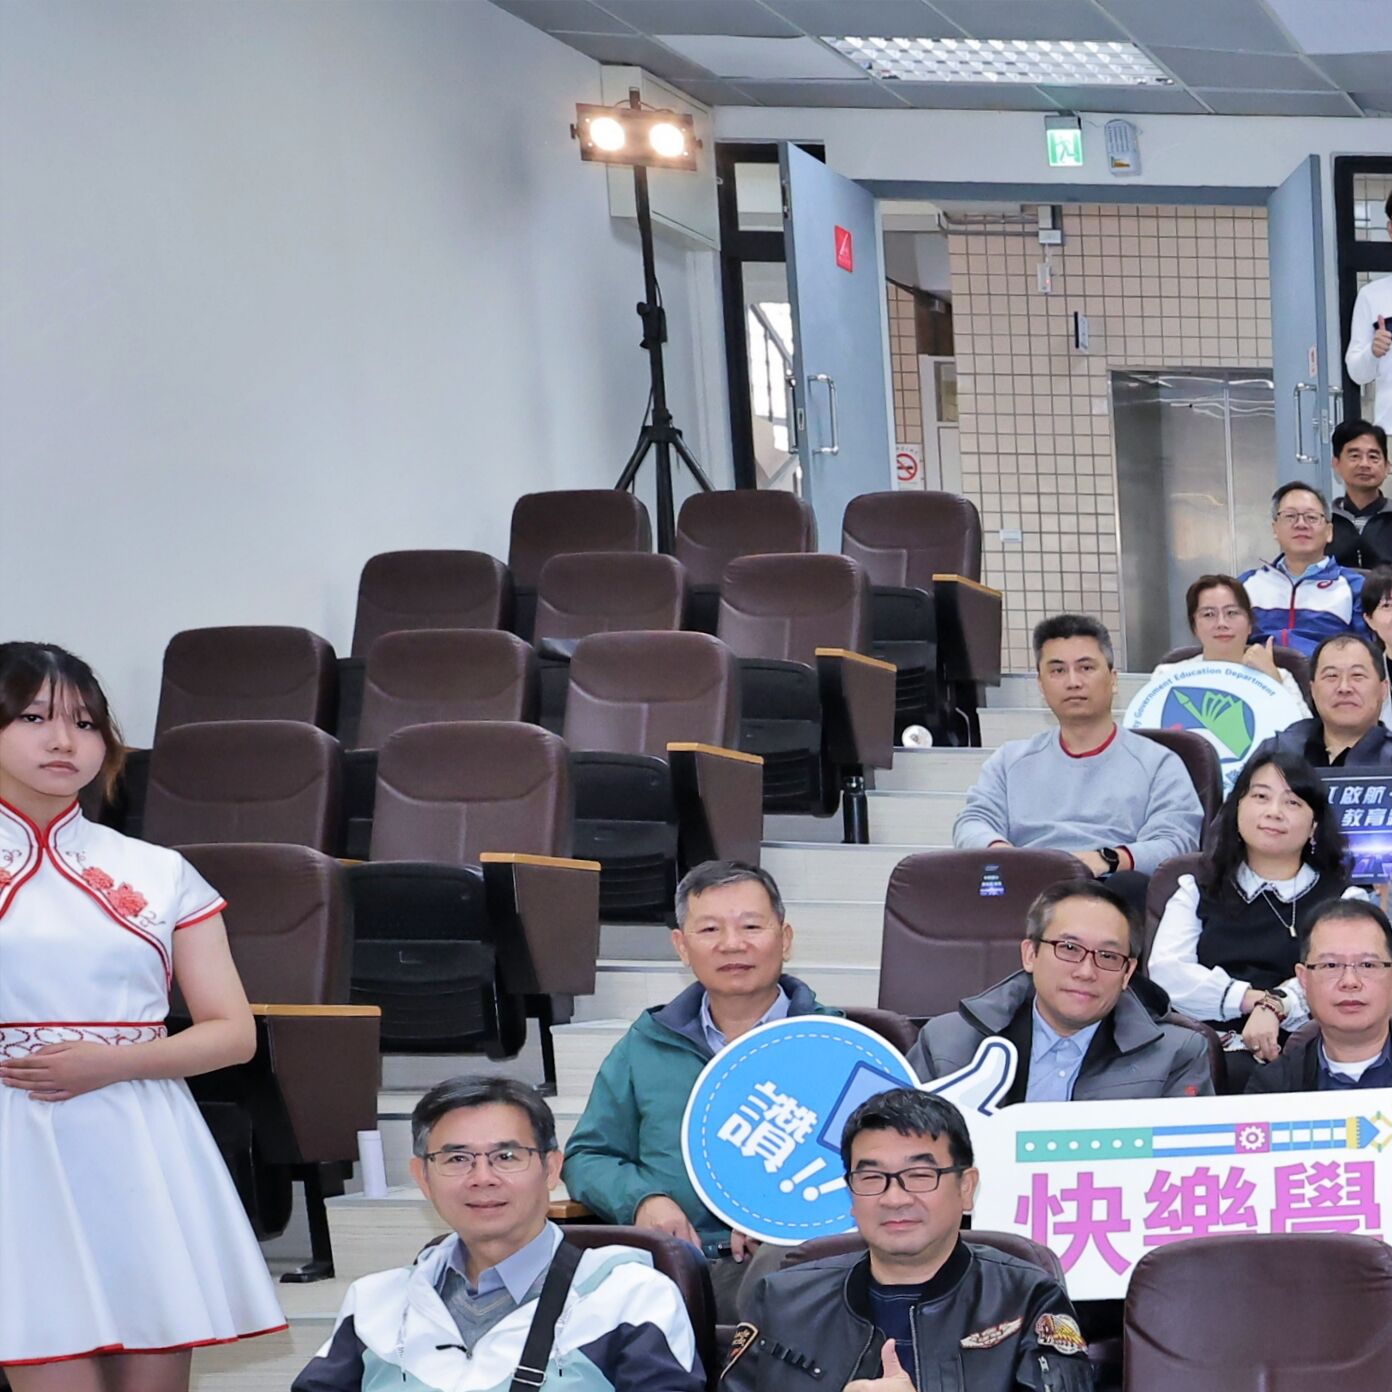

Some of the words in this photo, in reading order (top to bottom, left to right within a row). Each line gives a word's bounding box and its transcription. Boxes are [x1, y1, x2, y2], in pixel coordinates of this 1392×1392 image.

[1134, 677, 1175, 719] Government
[1174, 665, 1223, 681] Education
[1225, 667, 1277, 698] Department
